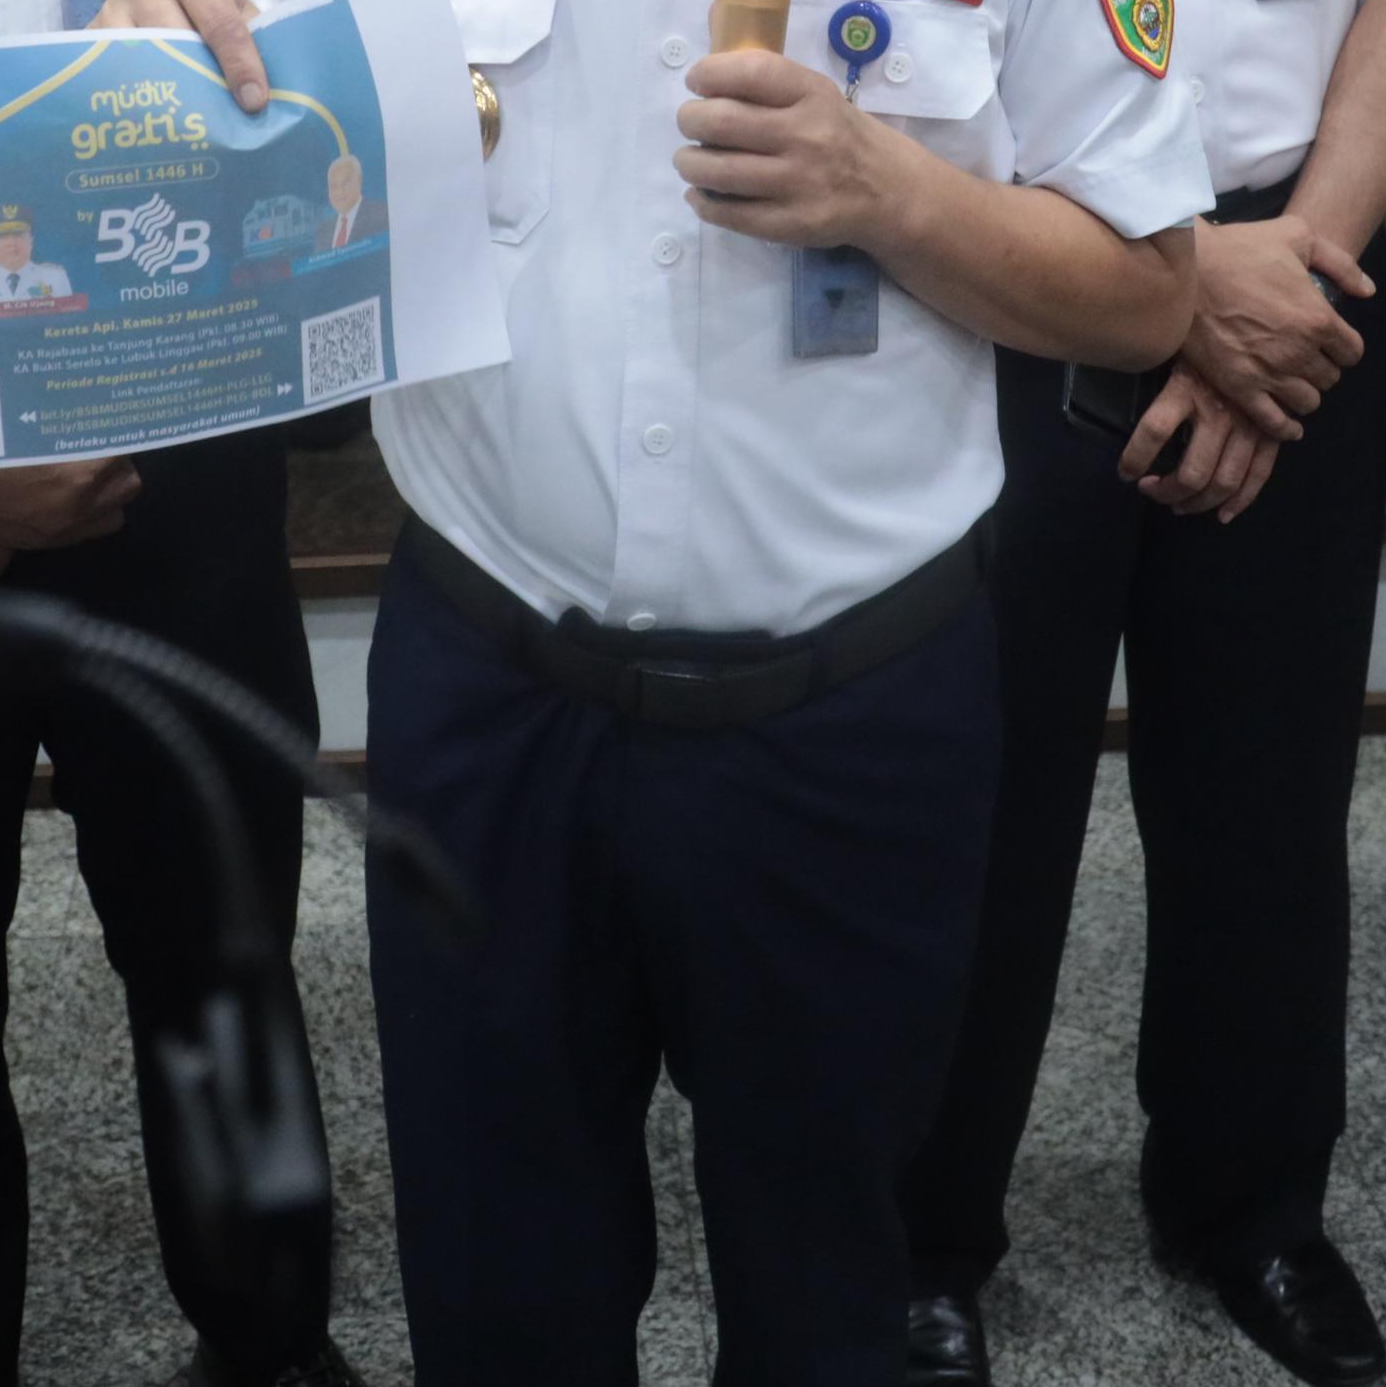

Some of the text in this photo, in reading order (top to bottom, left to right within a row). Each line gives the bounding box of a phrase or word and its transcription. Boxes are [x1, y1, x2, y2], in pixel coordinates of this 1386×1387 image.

[90, 80, 182, 116] mudik
[71, 106, 210, 160] gratis
[78, 162, 205, 188] Sumsel 1446 H
[76, 210, 94, 226] by
[119, 279, 190, 303] mobile
[43, 324, 90, 339] Kereta
[122, 315, 164, 330] Kamis
[166, 313, 182, 326] 27
[187, 306, 225, 322] Maret
[227, 298, 259, 314] 2025
[13, 363, 30, 375] KA
[32, 360, 63, 374] Bukit
[103, 354, 118, 366] ke
[120, 348, 157, 364] Lubuk
[158, 342, 204, 361] Linggau
[17, 348, 34, 361] KA
[36, 344, 88, 361] Rajabasa
[90, 342, 104, 354] ke
[106, 335, 153, 353] Tanjung
[155, 330, 195, 347] Karang
[46, 375, 94, 391] Periode
[96, 369, 158, 387] Registrasi
[196, 355, 232, 371] Maret
[233, 347, 263, 363] 2025
[110, 385, 133, 400] Link
[53, 404, 262, 452] (berlaku untuk masyarakat umum)
